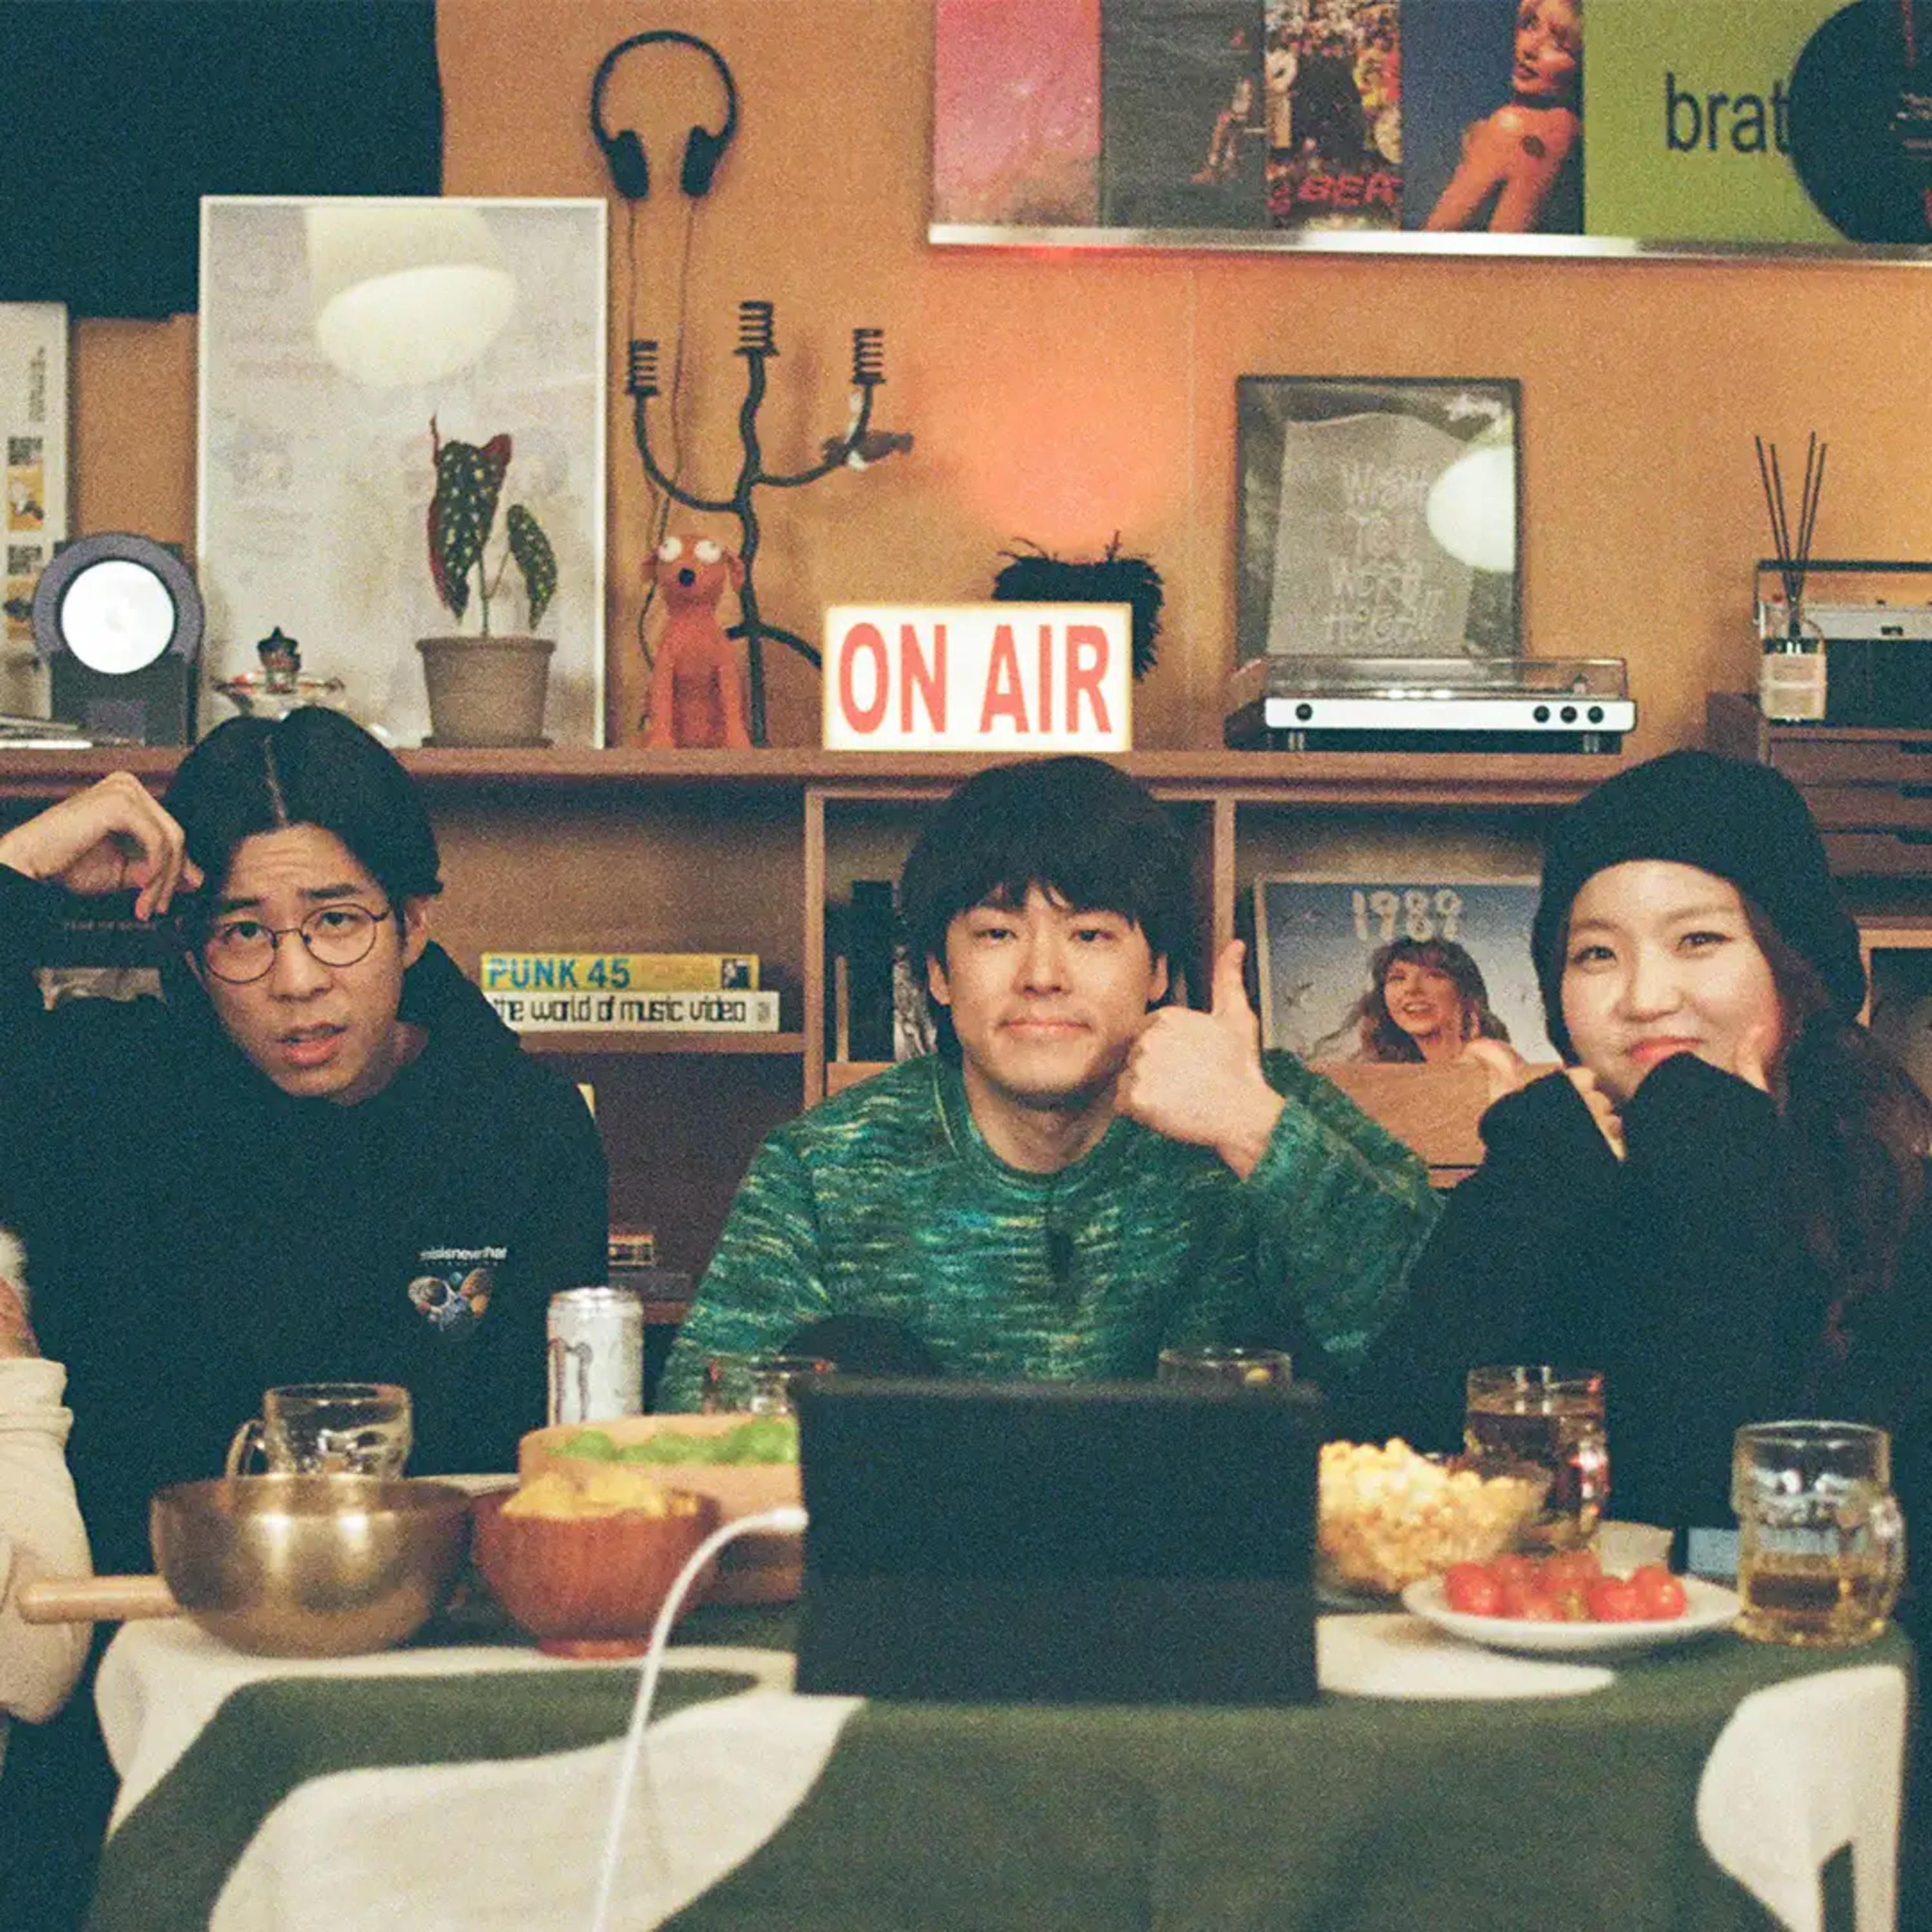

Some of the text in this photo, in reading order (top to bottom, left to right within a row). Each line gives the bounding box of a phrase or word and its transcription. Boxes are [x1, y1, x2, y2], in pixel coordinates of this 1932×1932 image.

[1665, 71, 1789, 153] brat
[838, 622, 1113, 734] ON AIR
[1352, 888, 1464, 944] 1989
[488, 958, 630, 989] PUNK 45
[531, 994, 592, 1023] world
[597, 994, 616, 1022] of
[620, 995, 684, 1023] music
[690, 995, 747, 1023] video
